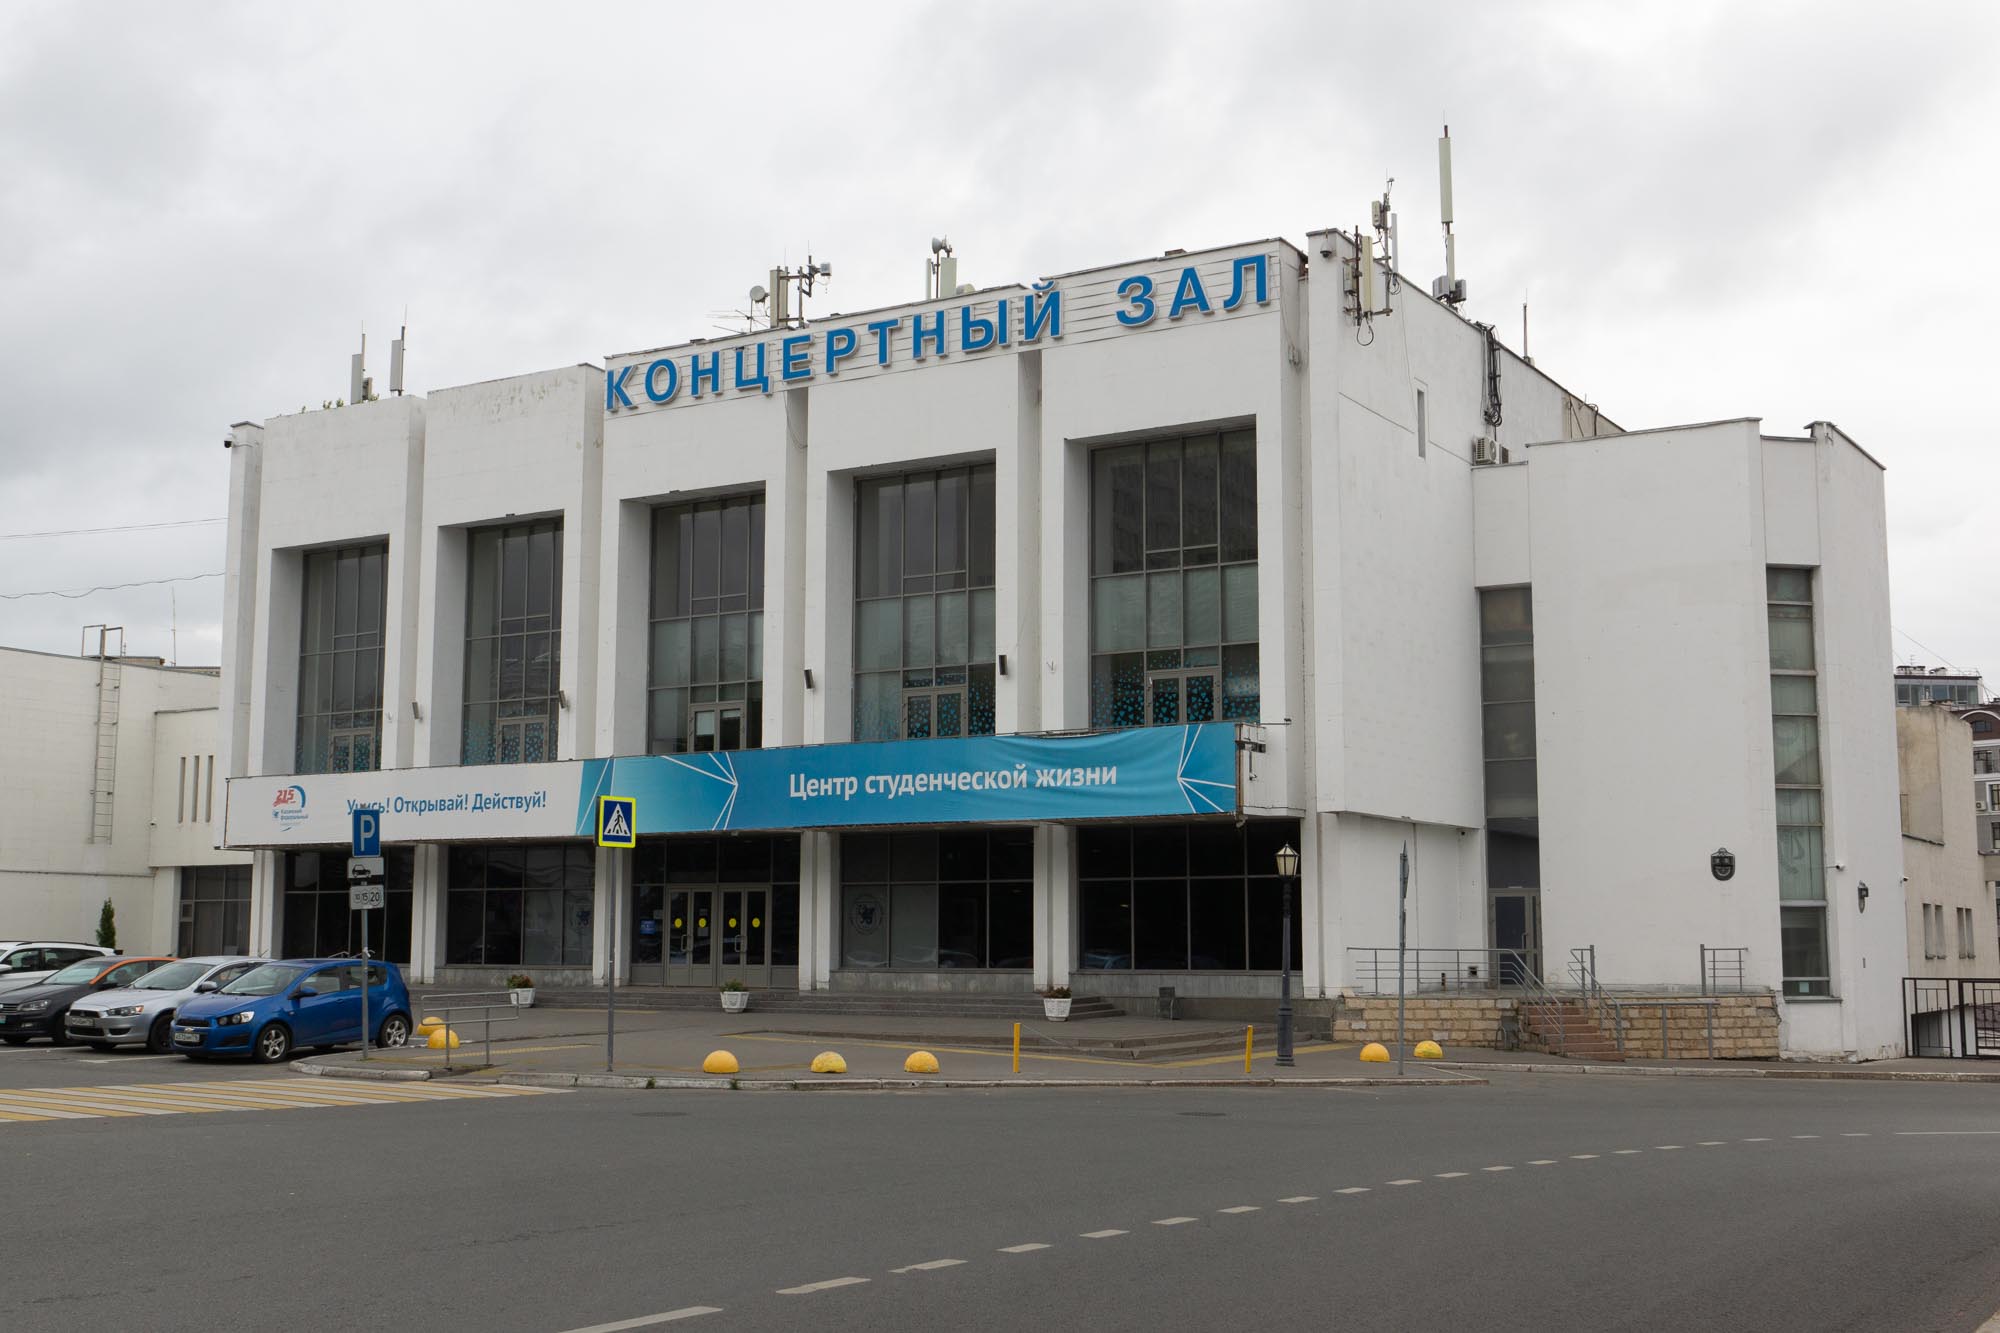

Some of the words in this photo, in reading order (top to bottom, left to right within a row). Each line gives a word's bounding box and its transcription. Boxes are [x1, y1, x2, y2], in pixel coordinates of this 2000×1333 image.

[605, 281, 1065, 415] КОНЦЕРТНЫЙ
[1114, 254, 1272, 328] ЗАЛ
[276, 789, 295, 803] 215
[789, 773, 858, 801] Центр
[864, 763, 1028, 799] студенческой
[1034, 765, 1117, 788] жизни
[394, 794, 468, 816] Открывай!
[472, 791, 546, 813] Действуй!
[360, 814, 376, 852] P
[370, 891, 380, 902] 20
